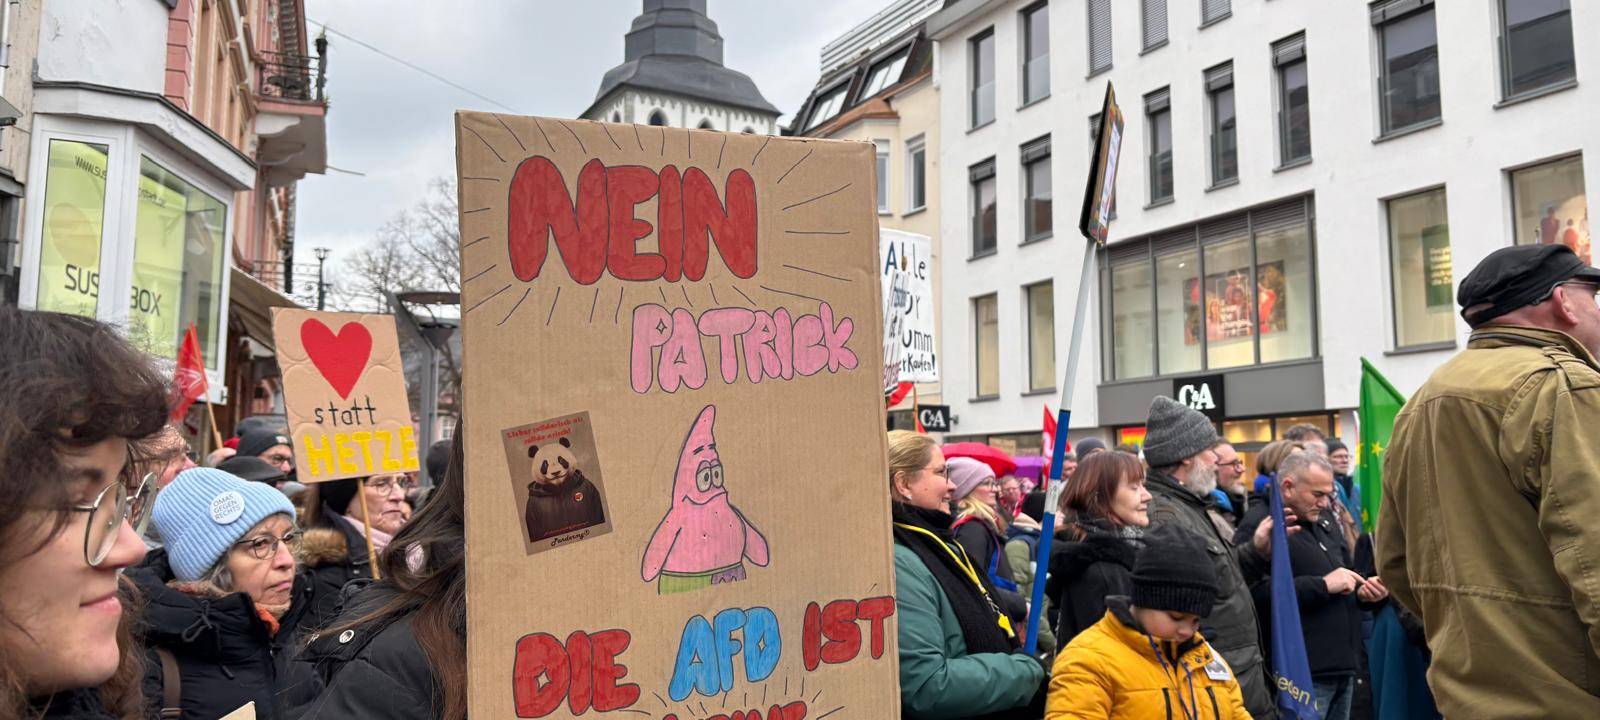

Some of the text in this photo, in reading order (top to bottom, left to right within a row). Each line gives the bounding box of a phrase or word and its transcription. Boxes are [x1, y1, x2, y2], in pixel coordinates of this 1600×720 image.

[508, 155, 758, 285] NEIN
[64, 263, 99, 298] SUS
[630, 302, 859, 393] PATRICK
[315, 395, 376, 426] statt
[1178, 383, 1216, 410] C&A
[920, 408, 946, 428] C&A
[304, 426, 419, 477] HETZE
[213, 493, 234, 507] OMAS
[213, 499, 238, 514] GEGEN
[214, 504, 241, 520] RECHTS
[512, 596, 895, 718] DIE AFD IST
